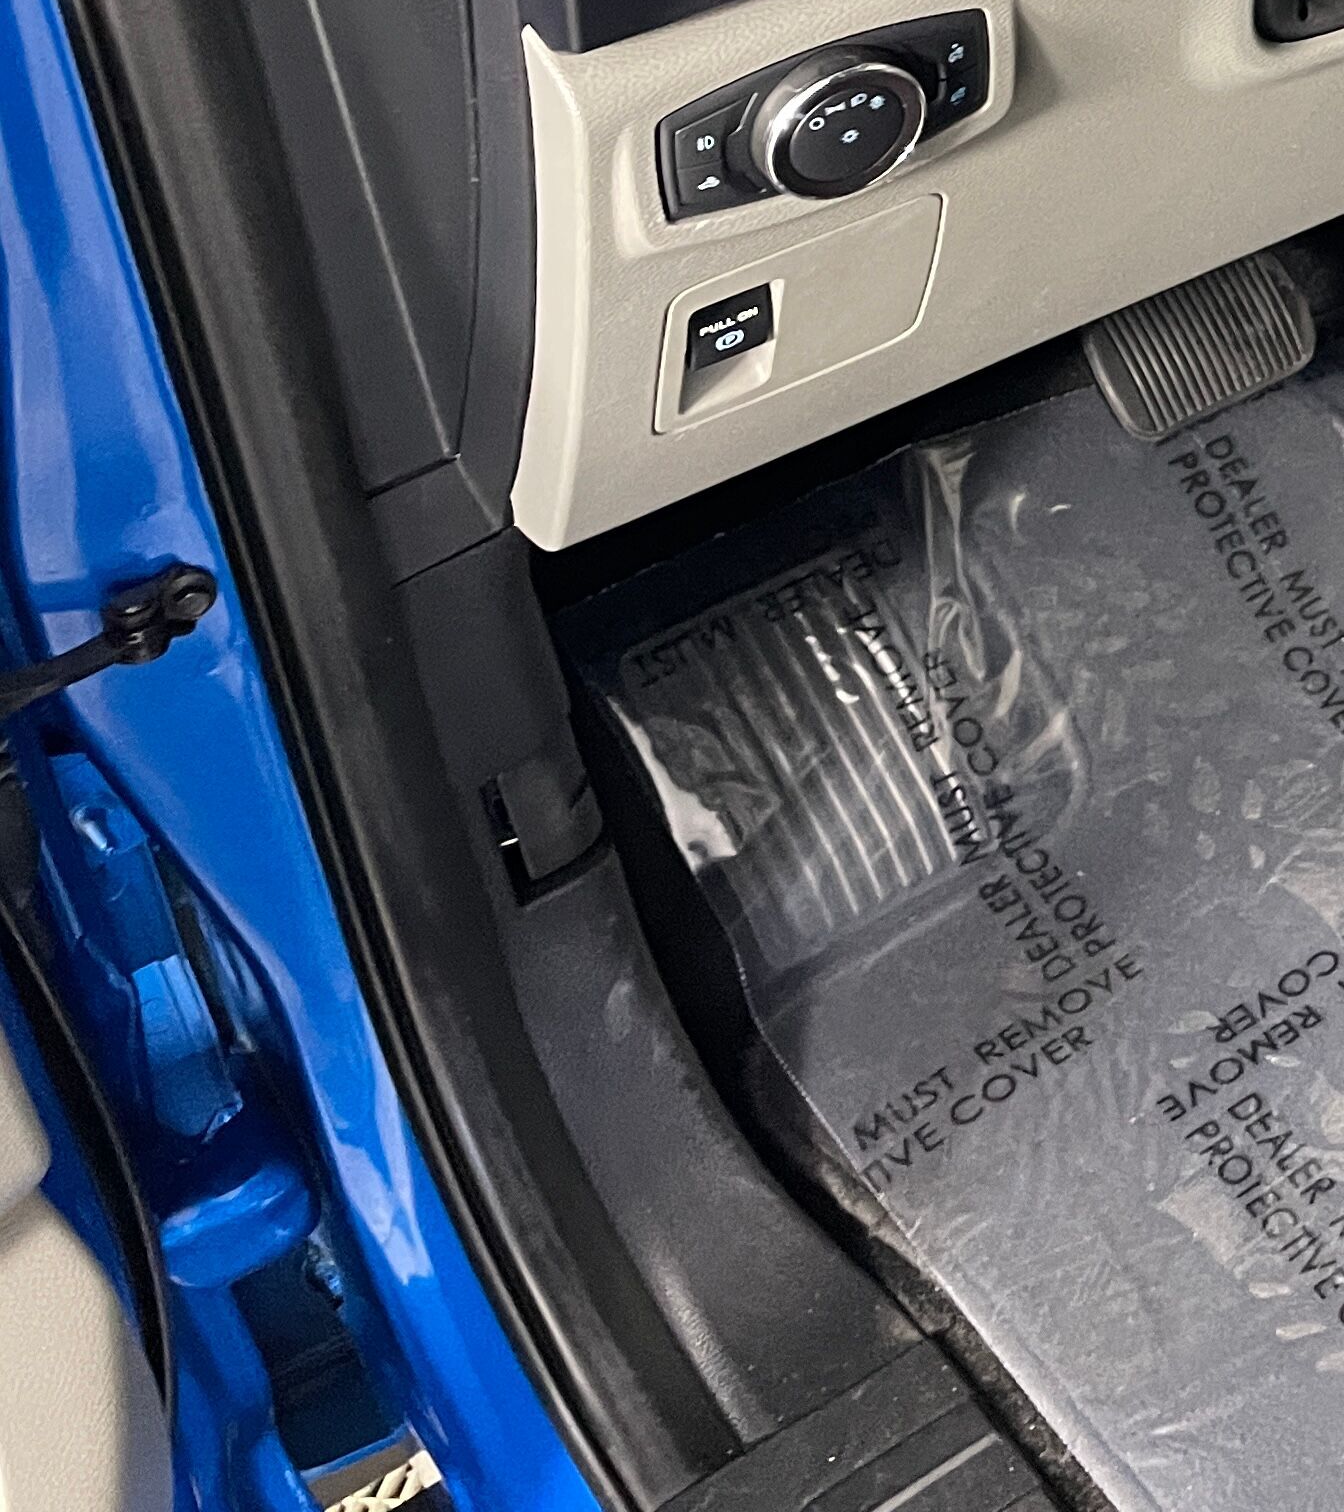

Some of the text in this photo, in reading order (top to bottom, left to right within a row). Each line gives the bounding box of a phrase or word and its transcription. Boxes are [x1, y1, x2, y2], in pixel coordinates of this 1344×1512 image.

[699, 317, 736, 337] PULL
[1167, 451, 1296, 643] PROTECTIVE
[1205, 435, 1288, 556] DEALER
[924, 649, 999, 776] COVER
[930, 771, 988, 866] MUST
[979, 874, 1077, 982] DEALER
[1207, 950, 1339, 1043] COVER
[853, 953, 1143, 1152] MUST REMOVE
[951, 1026, 1093, 1125] COVER
[1156, 1005, 1324, 1121] REMOVE
[1227, 1093, 1335, 1204] DEALER
